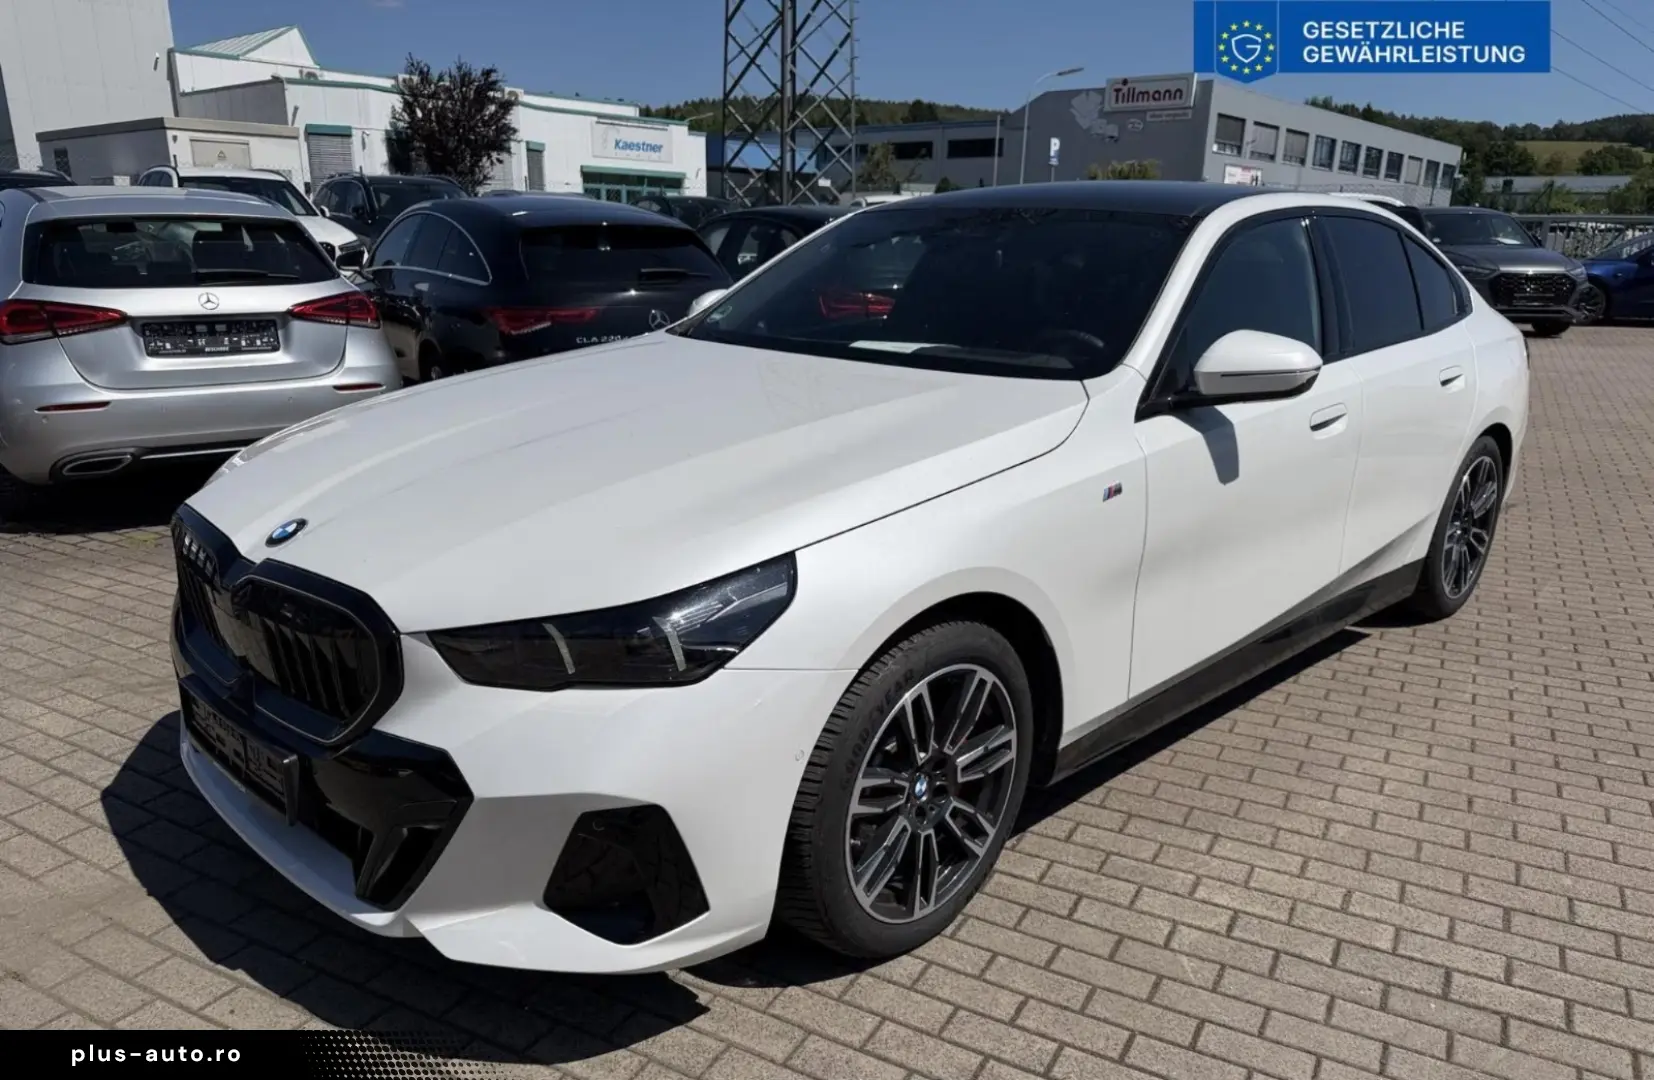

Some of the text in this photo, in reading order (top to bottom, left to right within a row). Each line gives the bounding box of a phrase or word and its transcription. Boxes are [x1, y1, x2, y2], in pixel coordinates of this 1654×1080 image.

[1113, 78, 1184, 105] Tillmann
[614, 139, 664, 153] Kaestner
[576, 336, 599, 344] CLA
